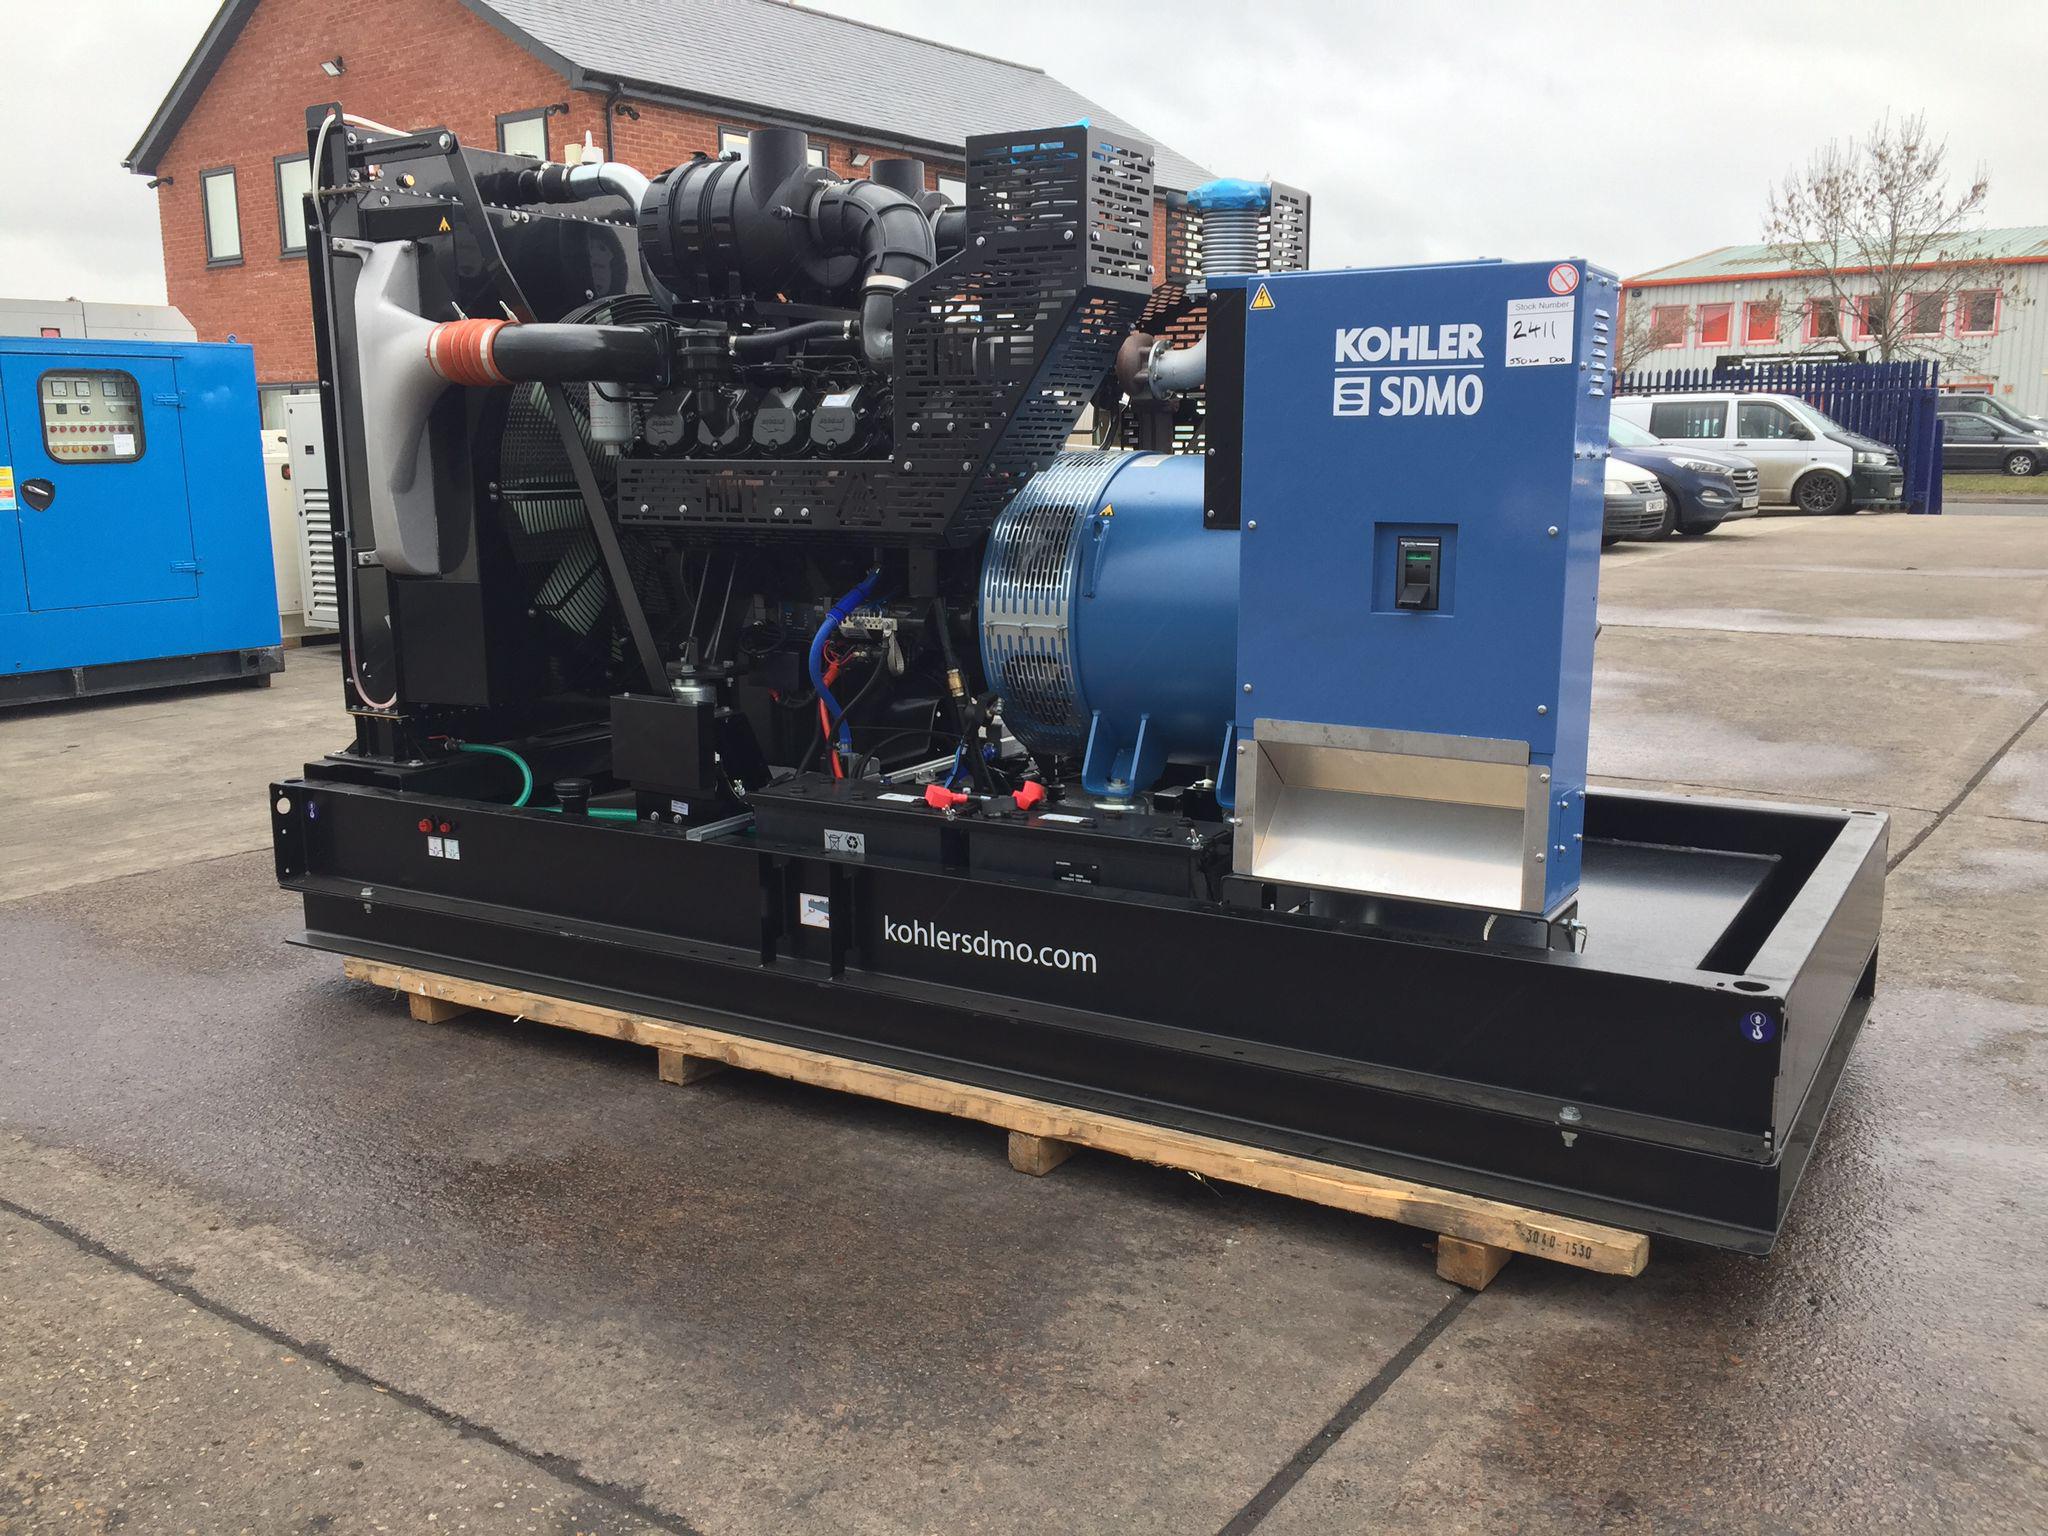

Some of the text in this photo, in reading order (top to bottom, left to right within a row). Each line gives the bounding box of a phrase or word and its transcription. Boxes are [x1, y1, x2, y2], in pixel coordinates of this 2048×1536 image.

[1515, 301, 1569, 311] Stock Number
[1335, 323, 1485, 363] KOHLER
[1513, 320, 1556, 340] 2411
[1378, 374, 1484, 417] SDMO
[884, 914, 1097, 973] kohlersdmo.com
